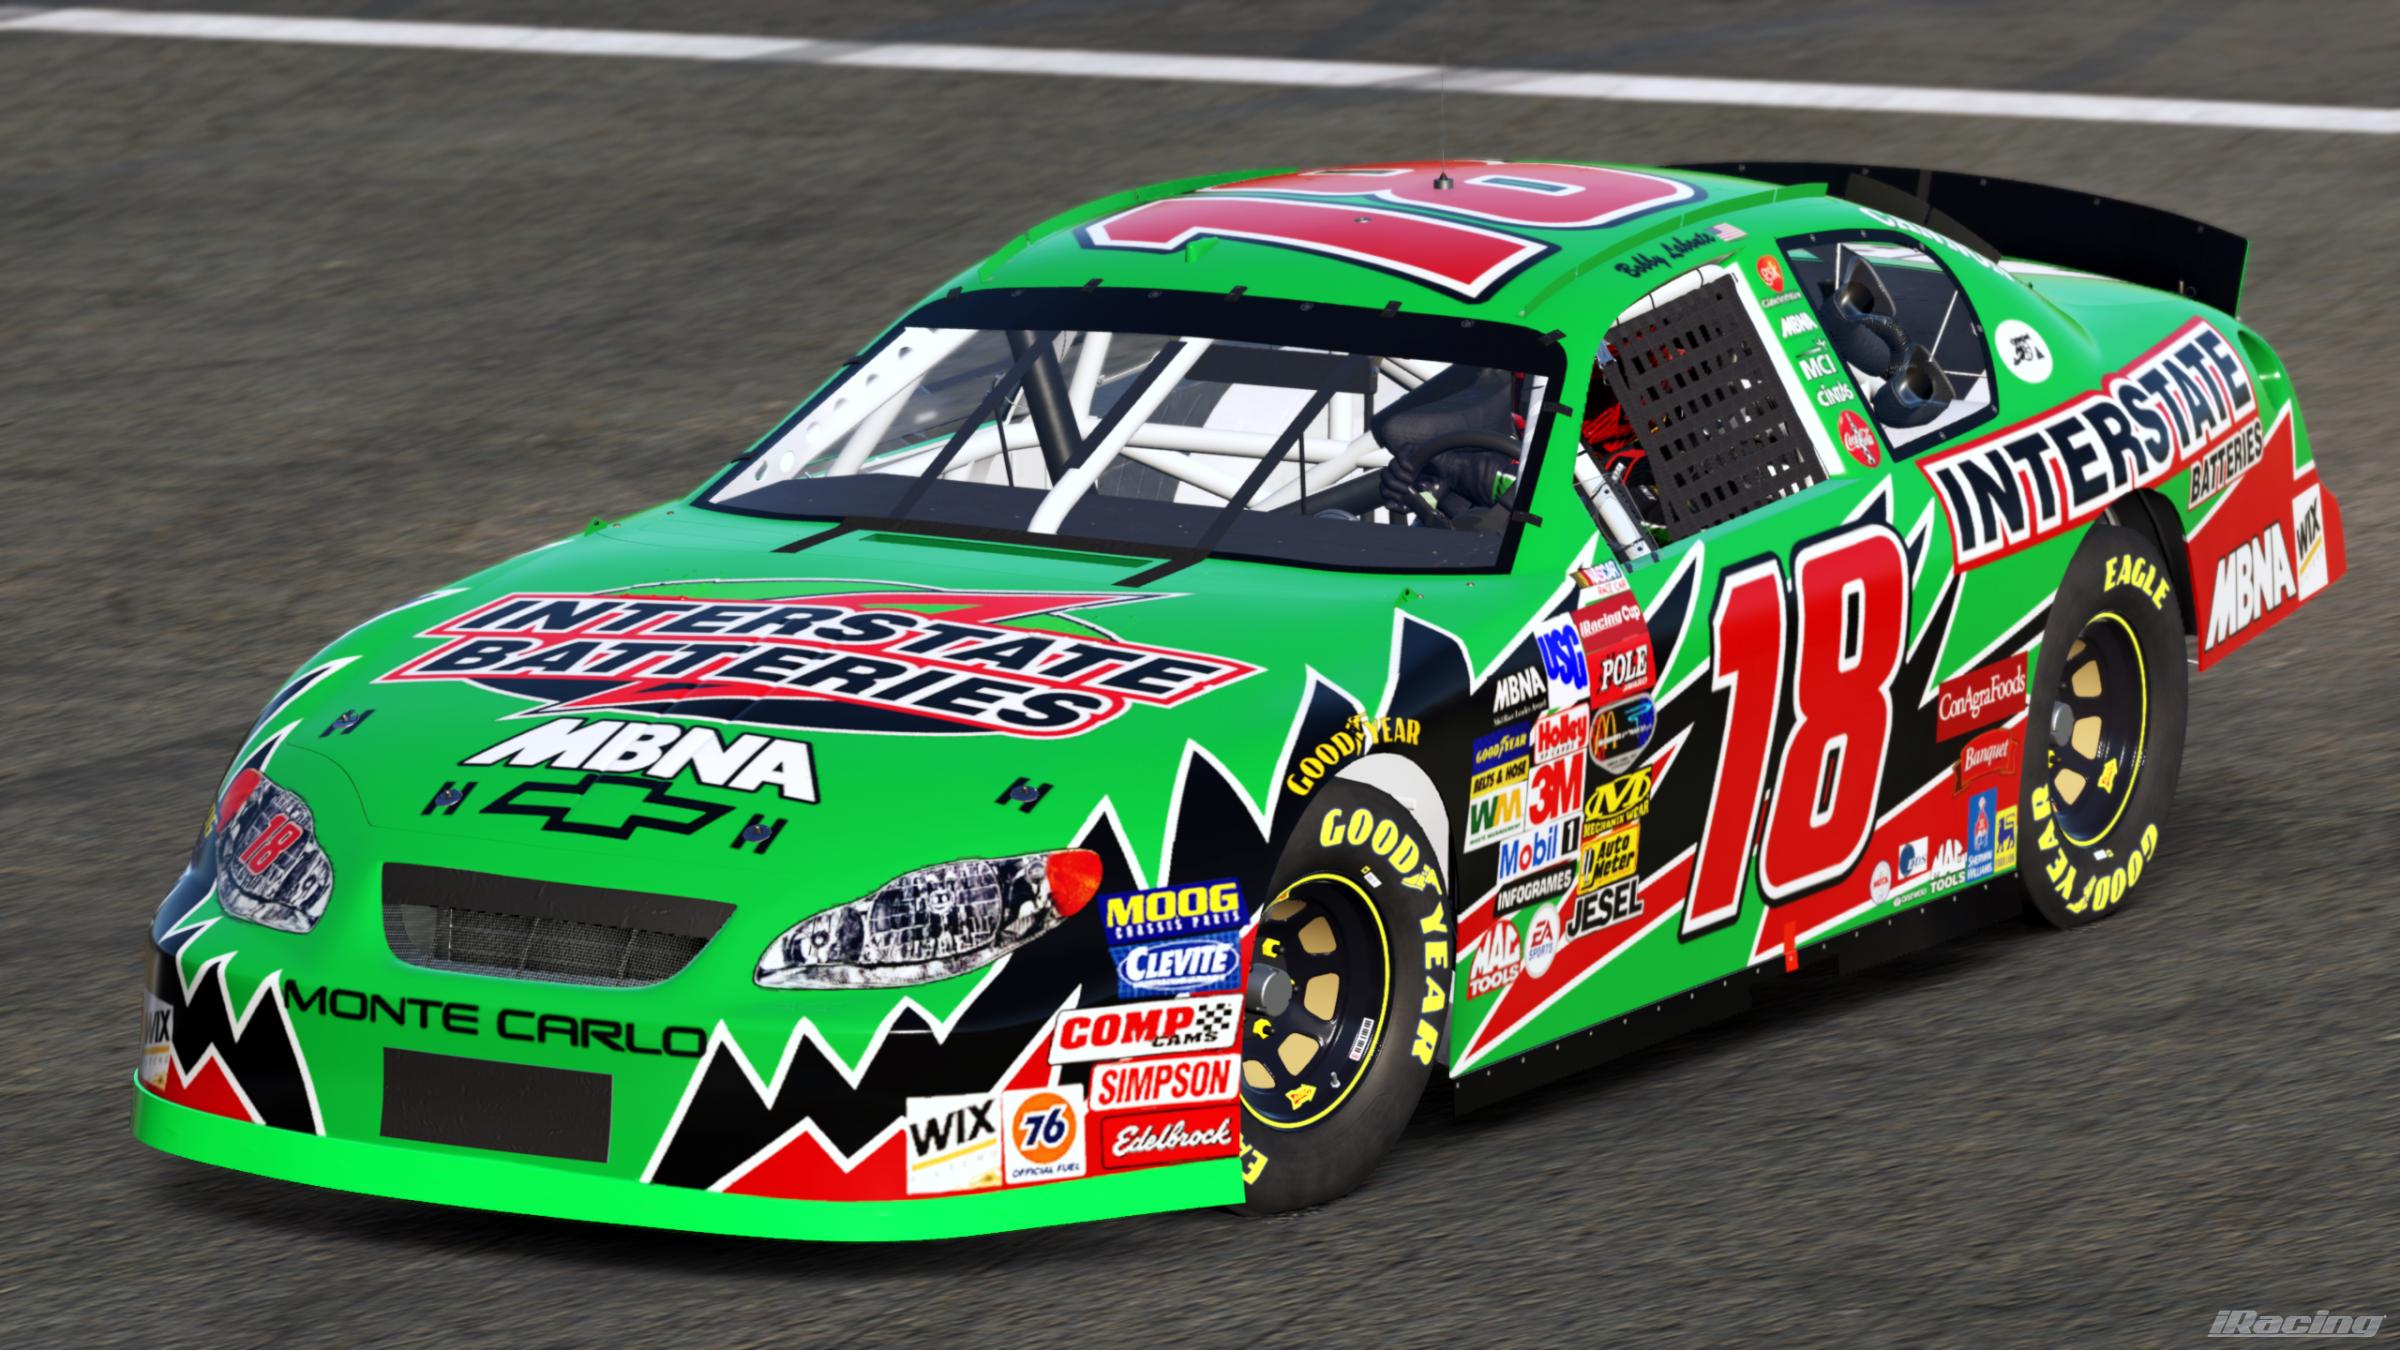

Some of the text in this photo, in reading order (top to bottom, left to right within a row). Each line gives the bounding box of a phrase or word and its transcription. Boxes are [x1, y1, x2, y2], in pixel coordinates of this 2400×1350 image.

[1781, 312, 1818, 338] MBNA
[1799, 356, 1836, 381] MCI
[1936, 329, 2251, 553] INTERSTATE
[2190, 421, 2262, 503] BATTERIES
[2297, 497, 2320, 560] WIX
[2104, 553, 2170, 610] EAGLE
[2205, 521, 2296, 652] MBNA
[1621, 604, 1641, 622] Cup
[456, 598, 1222, 695] INTERSTATE
[1601, 644, 1648, 692] POLE
[415, 639, 1102, 728] BATTERIES
[1493, 665, 1547, 713] MBNA
[1537, 714, 1587, 753] Holley
[1686, 525, 1905, 934] 18
[460, 716, 821, 804] MBNA
[1474, 772, 1495, 794] BELTS
[1505, 760, 1527, 781] HOSE
[1964, 740, 2009, 772] Banquet
[1529, 751, 1585, 825] 3M
[1471, 788, 1521, 835] WM
[1583, 800, 1650, 838] MECHANIX WEAR
[239, 813, 303, 876] 18
[1500, 824, 1558, 879] Mobil
[1594, 851, 1635, 878] Meter
[1599, 834, 1631, 858] Auto
[1931, 838, 1968, 881] MAC
[1497, 869, 1572, 911] INFOGRAMES
[1930, 870, 1966, 893] TOOLS
[1107, 882, 1240, 928] MOOG
[1115, 910, 1240, 940] CHASSIS PARTS
[1567, 880, 1643, 938] JESEL
[1471, 921, 1521, 980] MAC
[1528, 943, 1554, 961] SPORTS
[1531, 919, 1553, 947] EA
[1470, 963, 1520, 997] TOOLS
[283, 979, 708, 1059] MONTE CARLO
[1060, 1005, 1195, 1051] COMP
[1152, 1030, 1219, 1048] CAMS
[1098, 1059, 1231, 1105] SIMPSON
[909, 1099, 996, 1157] WIX
[1021, 1104, 1068, 1151] 76
[1112, 1116, 1232, 1157] Edelbrock
[1012, 1162, 1080, 1178] OFFICIAL FUEL
